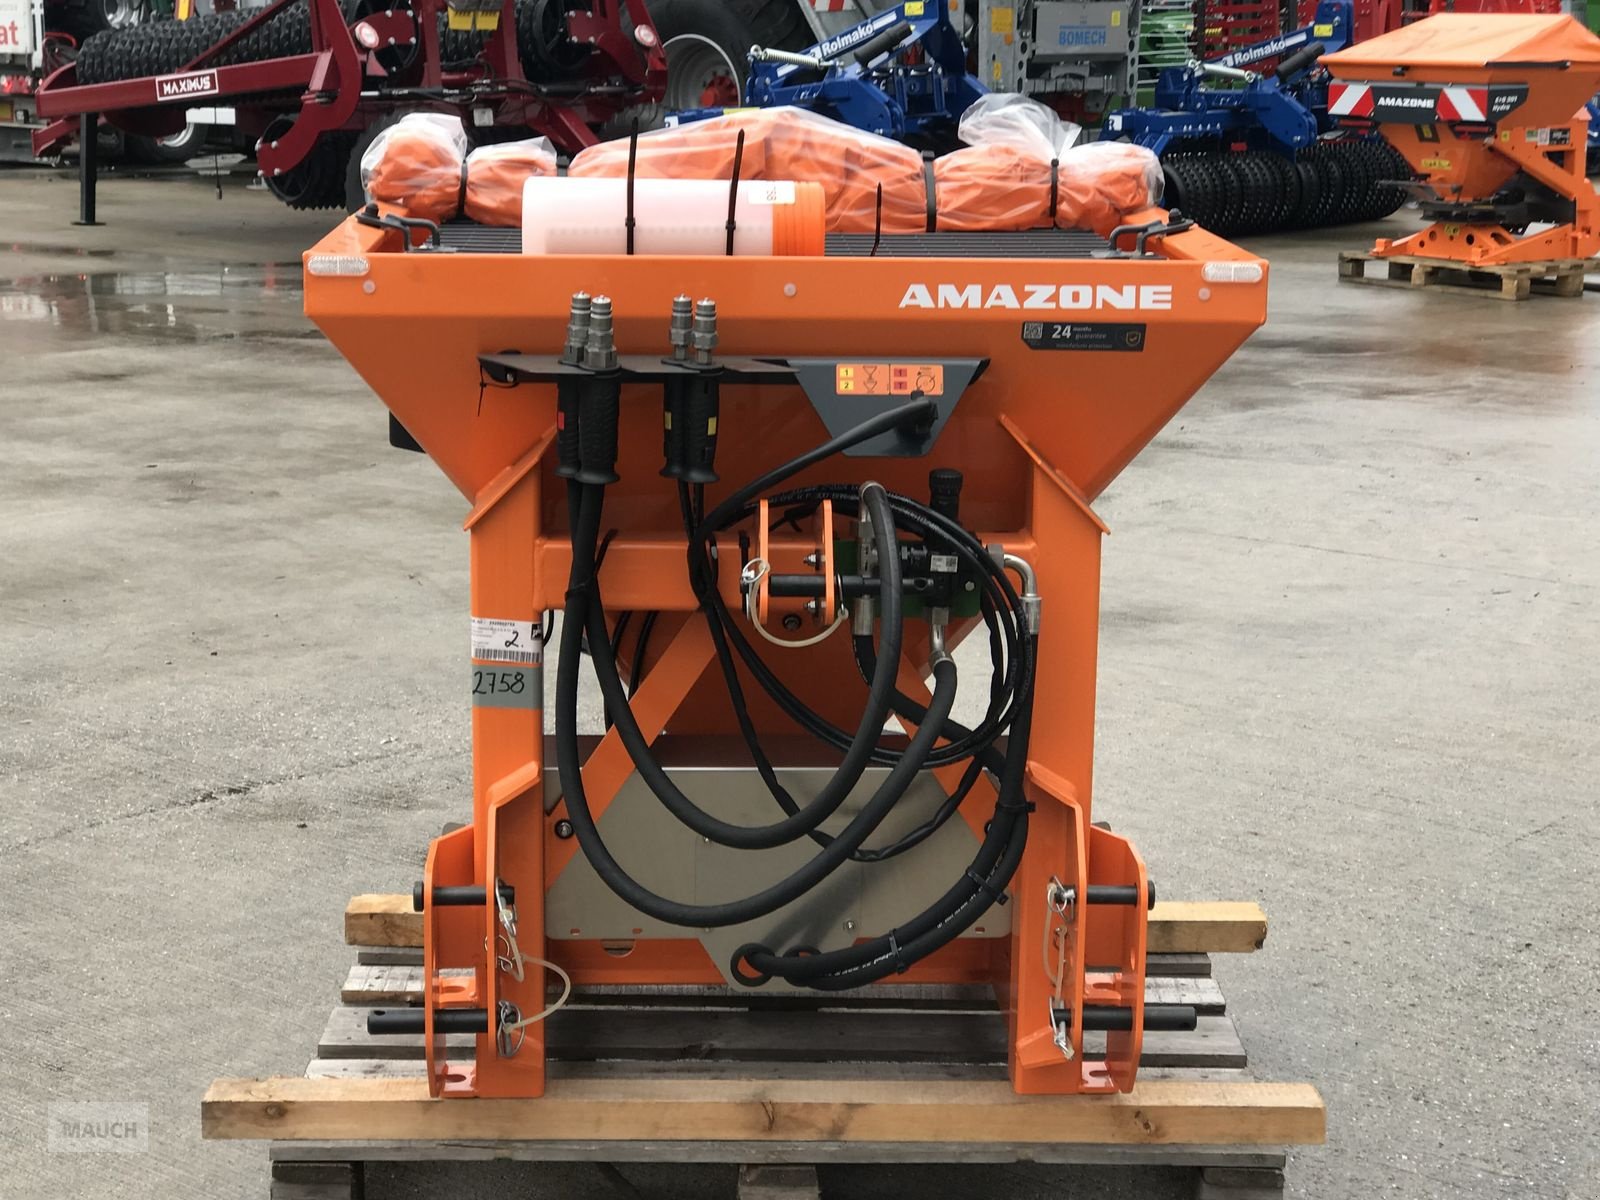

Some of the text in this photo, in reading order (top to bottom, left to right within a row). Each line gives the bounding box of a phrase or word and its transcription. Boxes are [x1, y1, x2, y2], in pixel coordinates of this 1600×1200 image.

[1059, 31, 1106, 46] BOMECH
[163, 76, 210, 95] MAXIMUS
[1377, 96, 1435, 109] AMAZONE
[899, 284, 1172, 310] AMAZONE
[1051, 324, 1073, 339] 24
[472, 671, 525, 695] 2758
